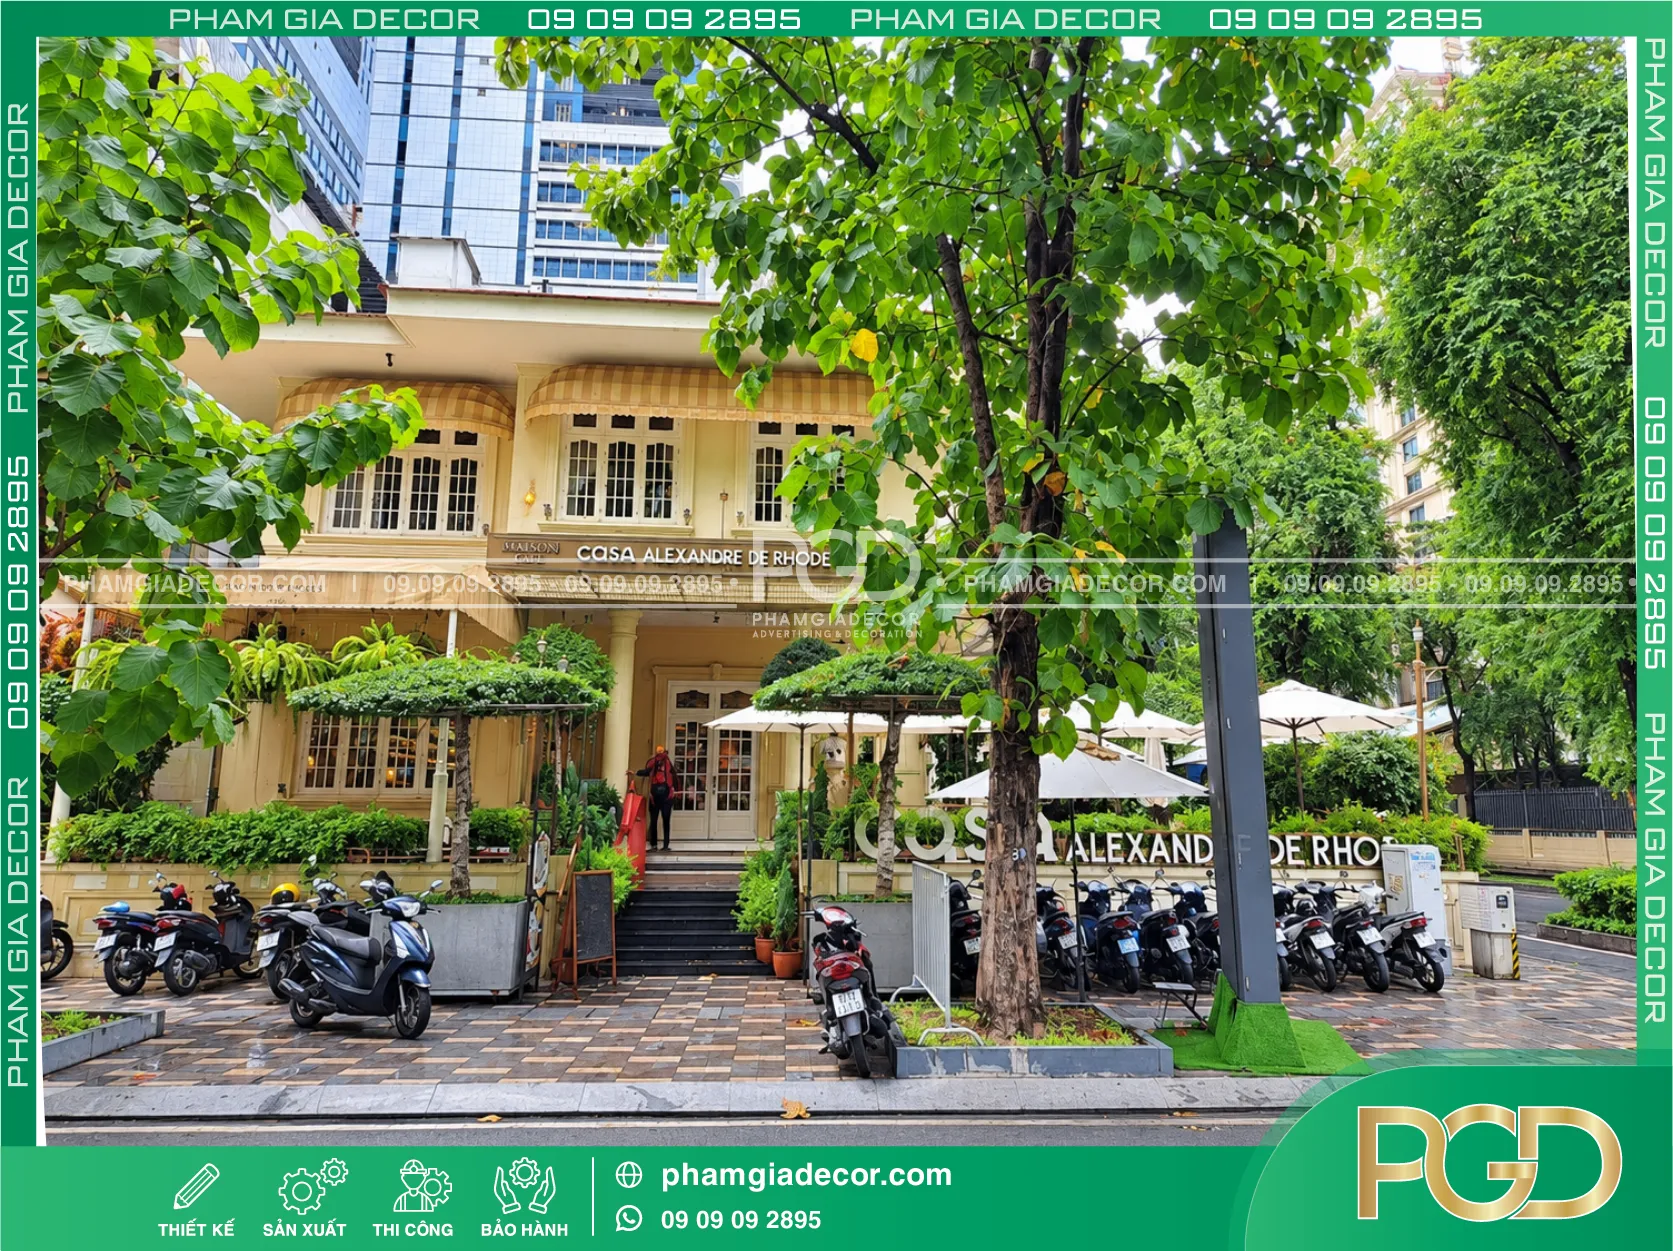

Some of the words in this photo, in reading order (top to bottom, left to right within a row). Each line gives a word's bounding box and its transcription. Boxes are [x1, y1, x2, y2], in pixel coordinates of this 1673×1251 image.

[503, 541, 560, 554] MAISON
[643, 546, 743, 565] ALEXANDRE
[748, 550, 769, 566] DE
[1066, 833, 1251, 863] ALEXAND
[1268, 834, 1305, 866] DE
